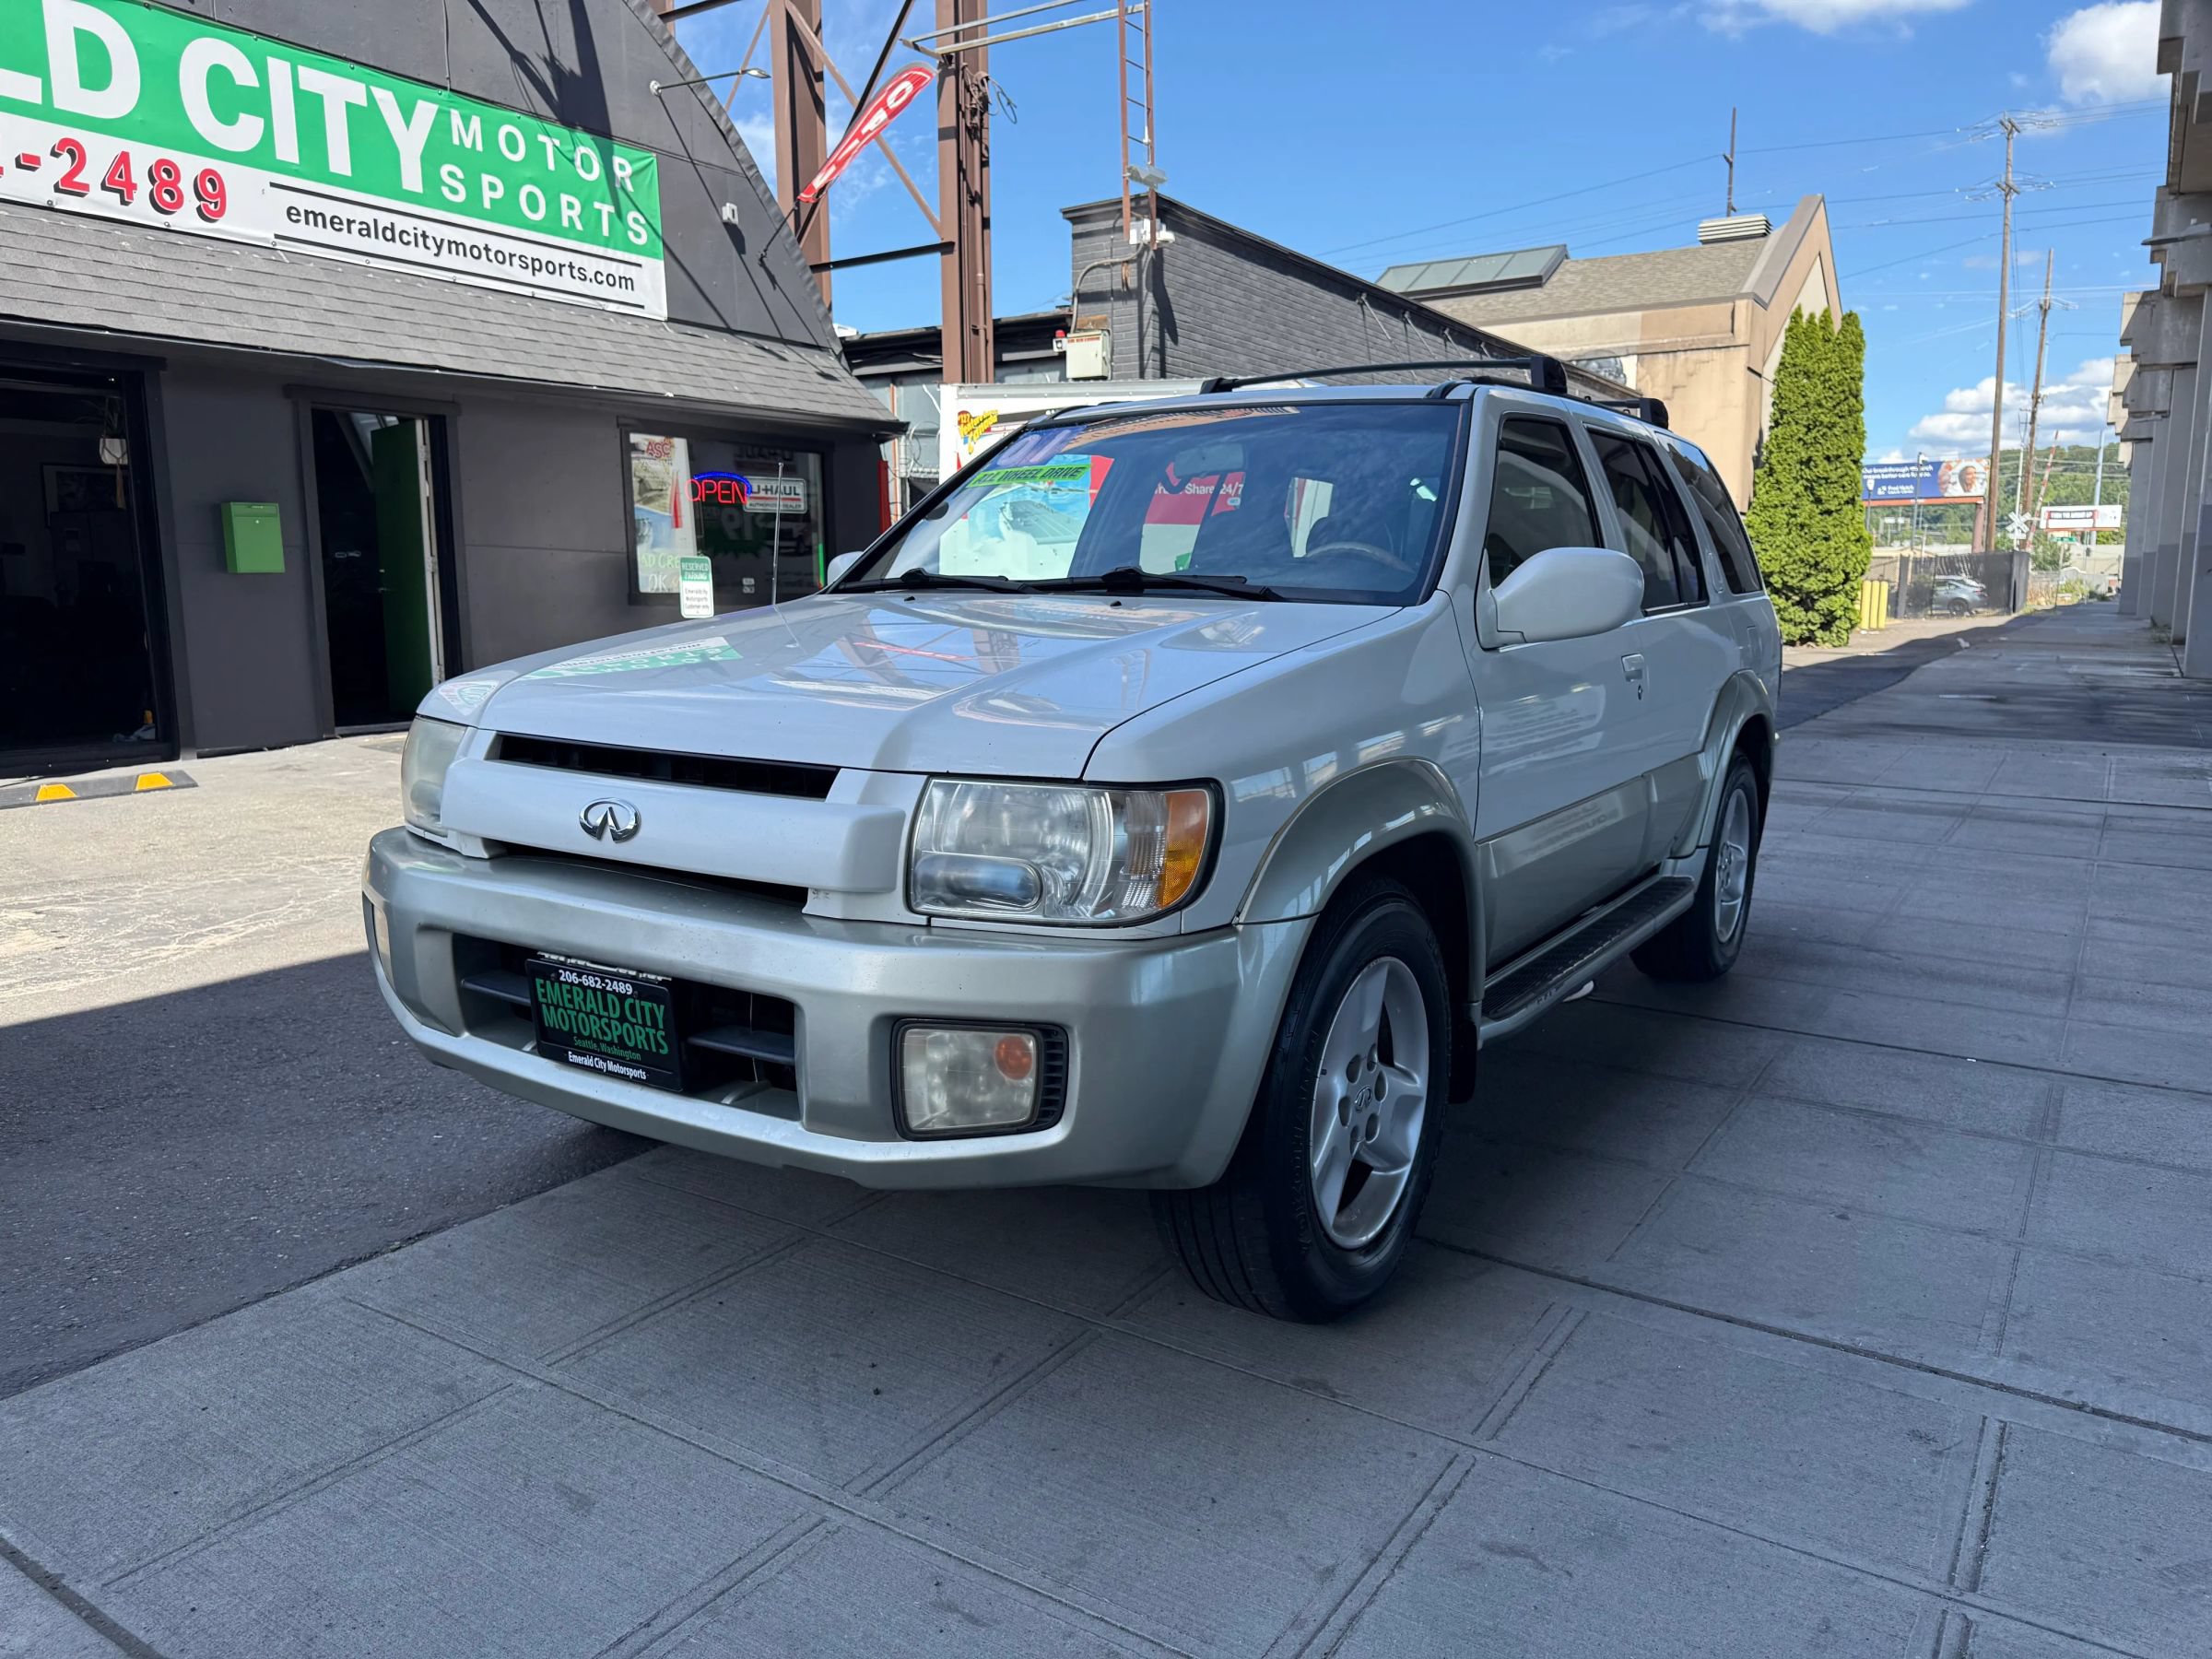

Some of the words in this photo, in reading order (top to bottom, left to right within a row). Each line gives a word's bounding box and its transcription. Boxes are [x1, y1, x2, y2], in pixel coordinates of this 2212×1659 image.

[179, 37, 439, 194] CITY
[450, 108, 634, 192] MOTOR
[0, 137, 227, 223] -2489
[440, 163, 648, 245] SPORTS
[286, 206, 634, 291] emeraldcitymotorsports.com
[684, 478, 747, 505] OPEN
[998, 470, 1041, 481] WHEEL
[1041, 466, 1087, 478] DRIVE
[1184, 482, 1215, 494] Share
[1219, 482, 1243, 496] 24/7
[648, 573, 669, 592] OK
[559, 970, 633, 994] 206-682-2489
[535, 978, 620, 1018] EMERALD
[625, 997, 665, 1029] CITY
[542, 1004, 669, 1055] MOTORSPORTS
[573, 1036, 600, 1052] Seattle,
[600, 1042, 641, 1061] Washington
[568, 1051, 594, 1067] Emerald
[594, 1057, 606, 1073] City
[607, 1060, 646, 1079] Motorsports
